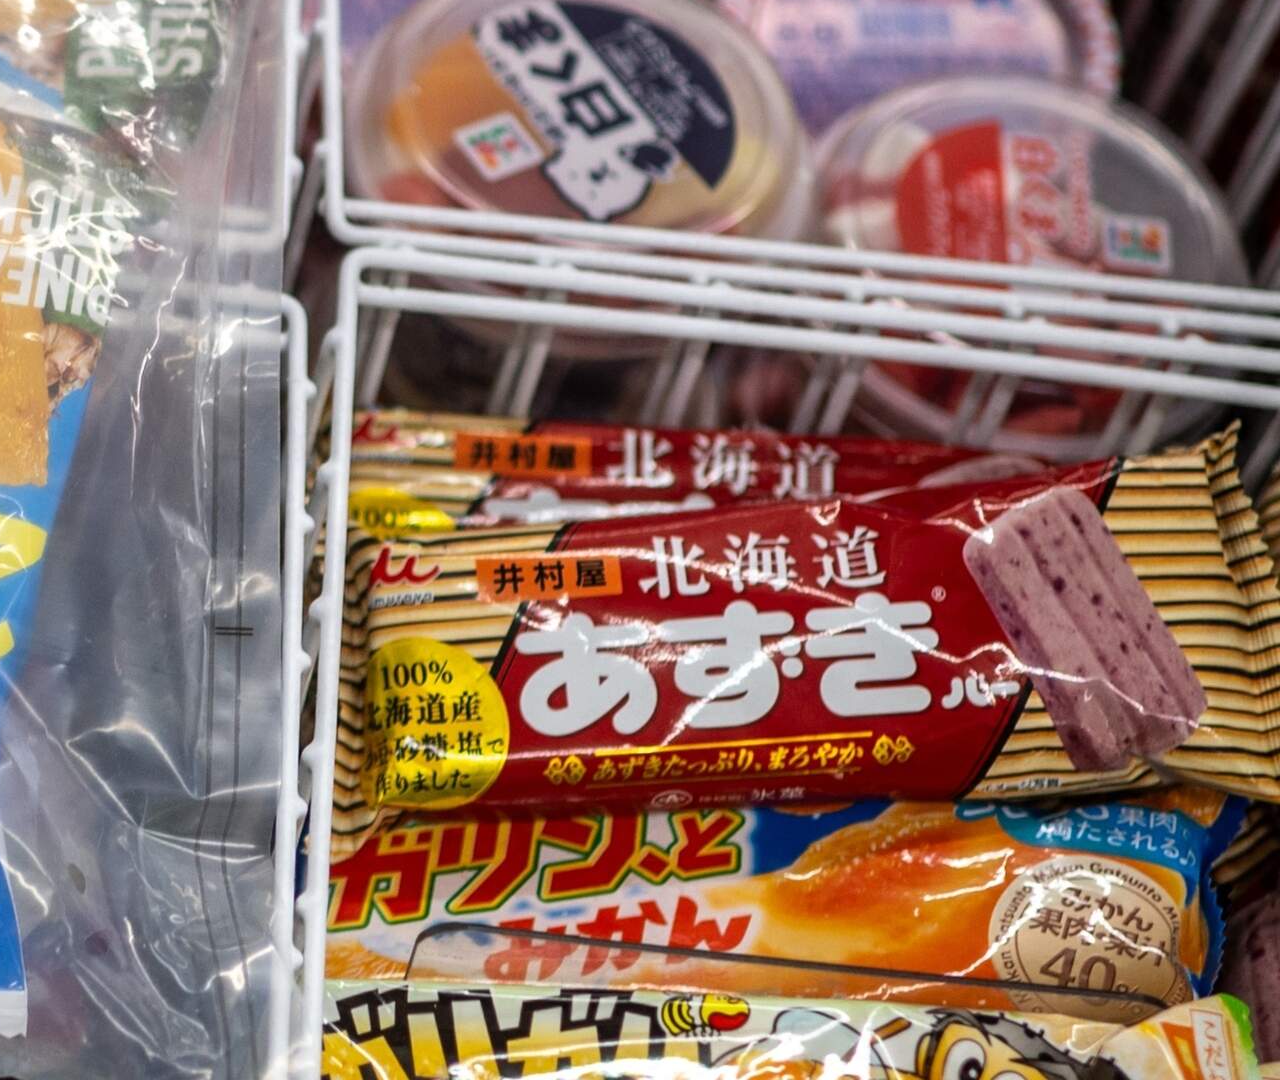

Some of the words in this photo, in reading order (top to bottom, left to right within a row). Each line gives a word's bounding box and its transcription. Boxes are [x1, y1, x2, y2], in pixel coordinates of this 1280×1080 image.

[494, 7, 632, 140] 白くま
[606, 428, 839, 502] 北海道
[493, 558, 608, 596] 井村屋
[638, 524, 888, 601] 北海道
[380, 658, 454, 692] 100%
[593, 741, 865, 780] あずきたっぷり、まろやか
[484, 896, 753, 981] みかん
